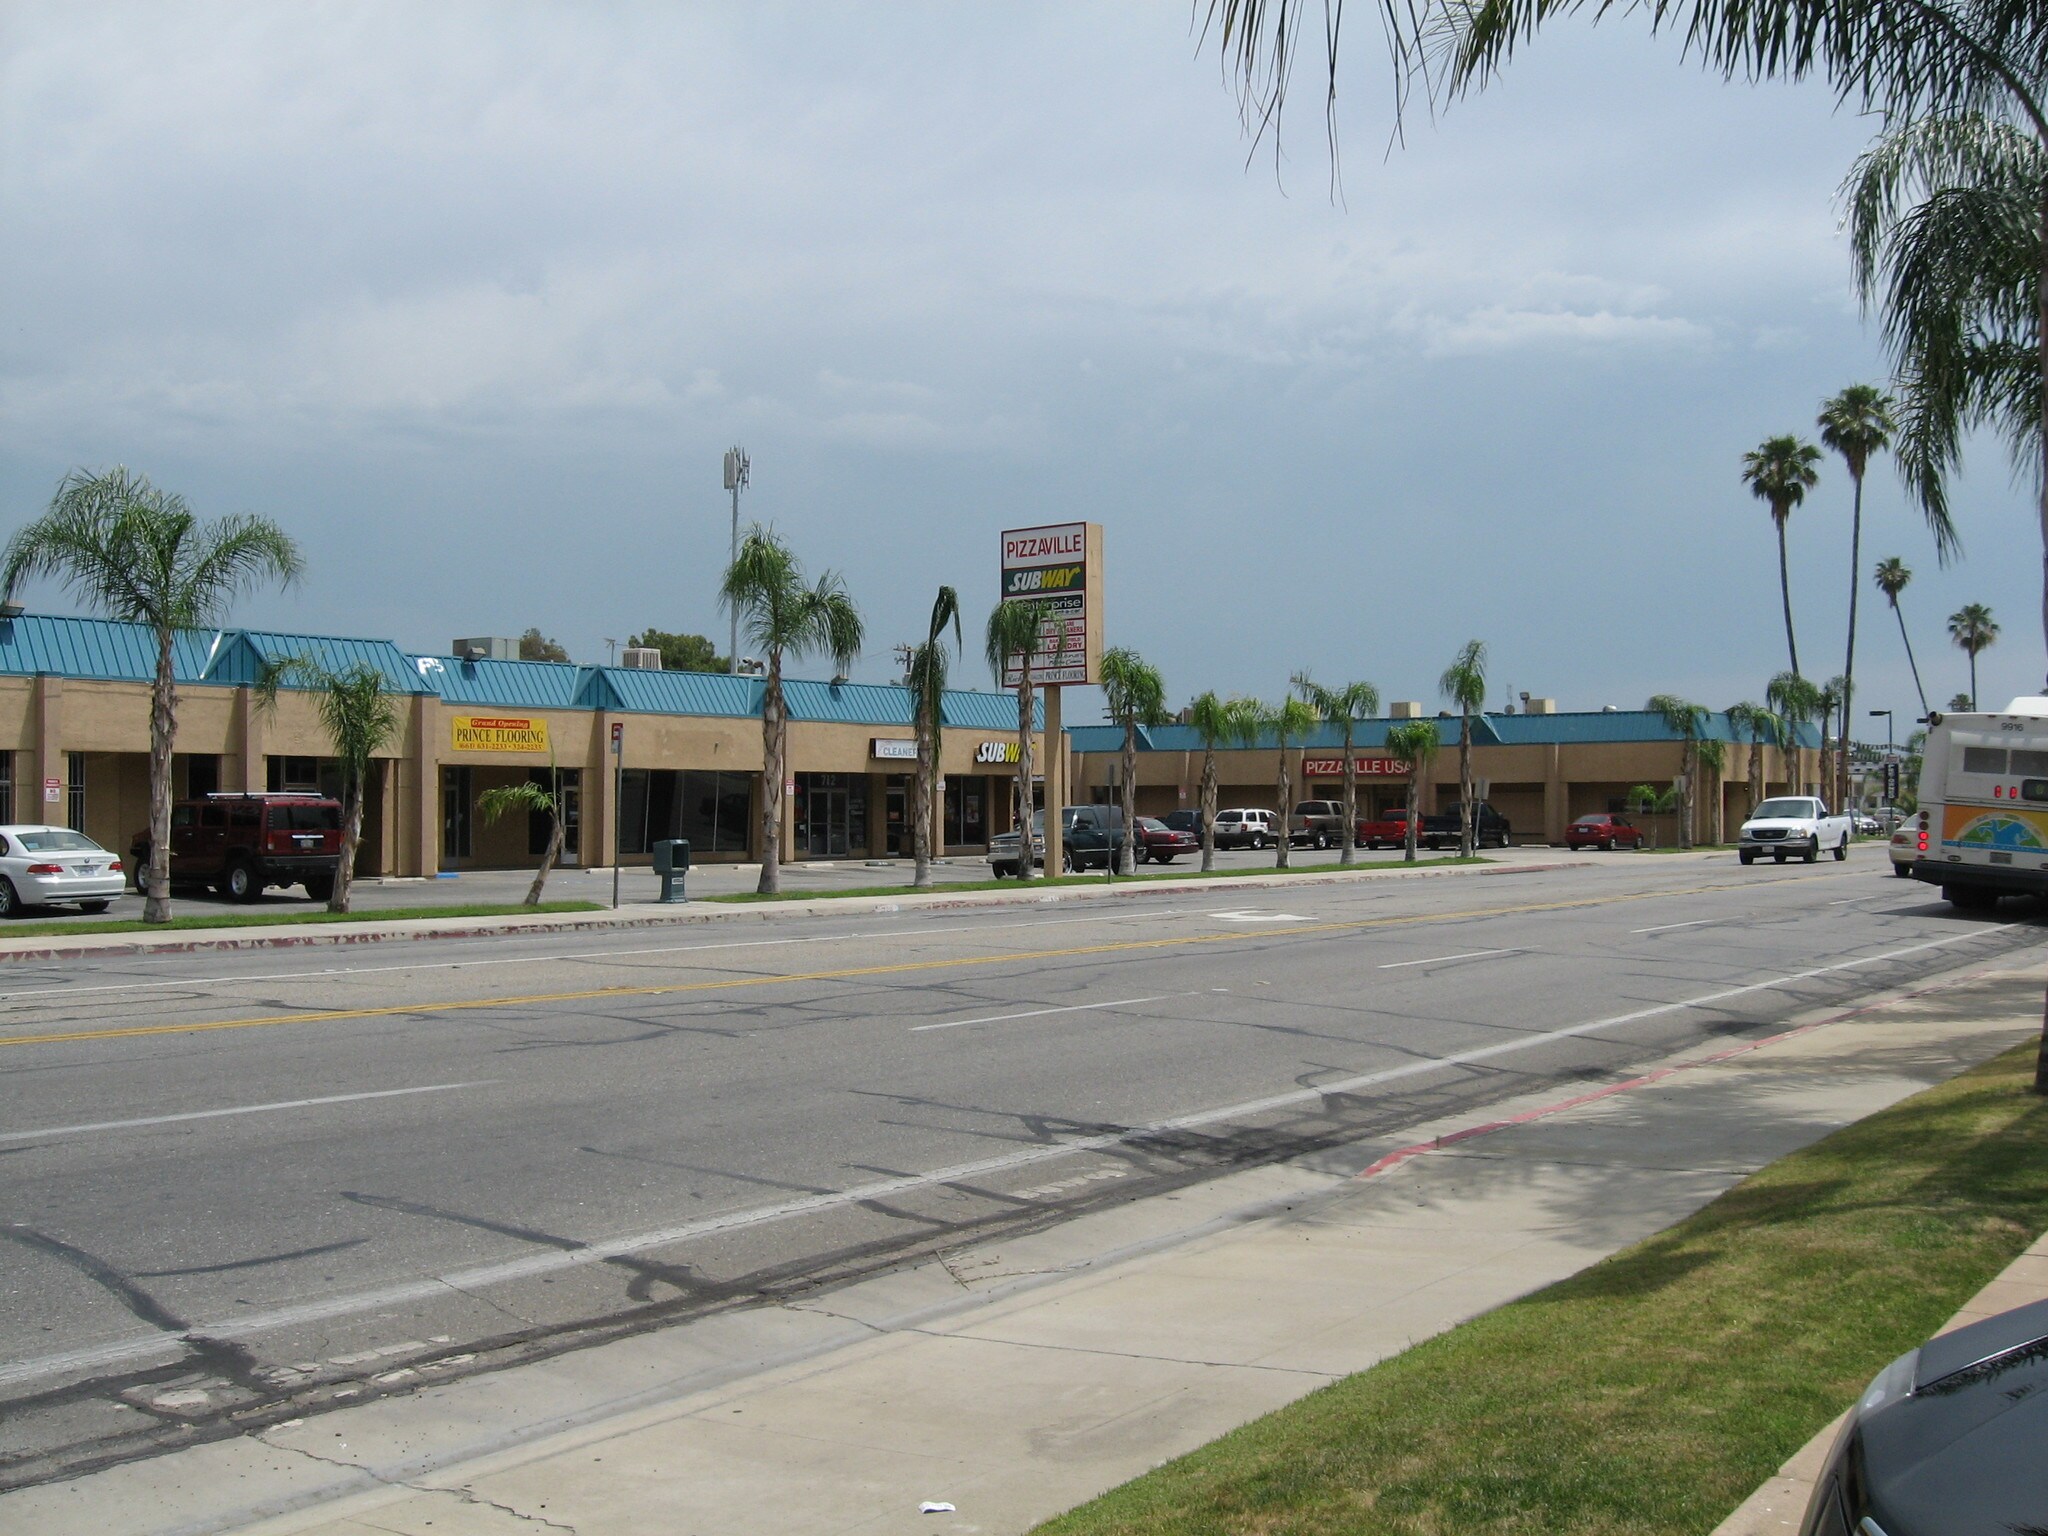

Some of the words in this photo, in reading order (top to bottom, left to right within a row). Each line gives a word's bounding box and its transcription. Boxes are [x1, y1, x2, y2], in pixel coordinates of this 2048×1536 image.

[1007, 534, 1081, 559] PIZZAVILLE
[1008, 565, 1081, 592] SUBWAY
[1047, 642, 1082, 650] LADRY
[472, 719, 496, 727] Grand
[498, 720, 528, 729] Opening
[457, 729, 491, 742] PRINCE
[496, 730, 543, 743] FLOORING
[1306, 760, 1380, 774] PIZZALLE
